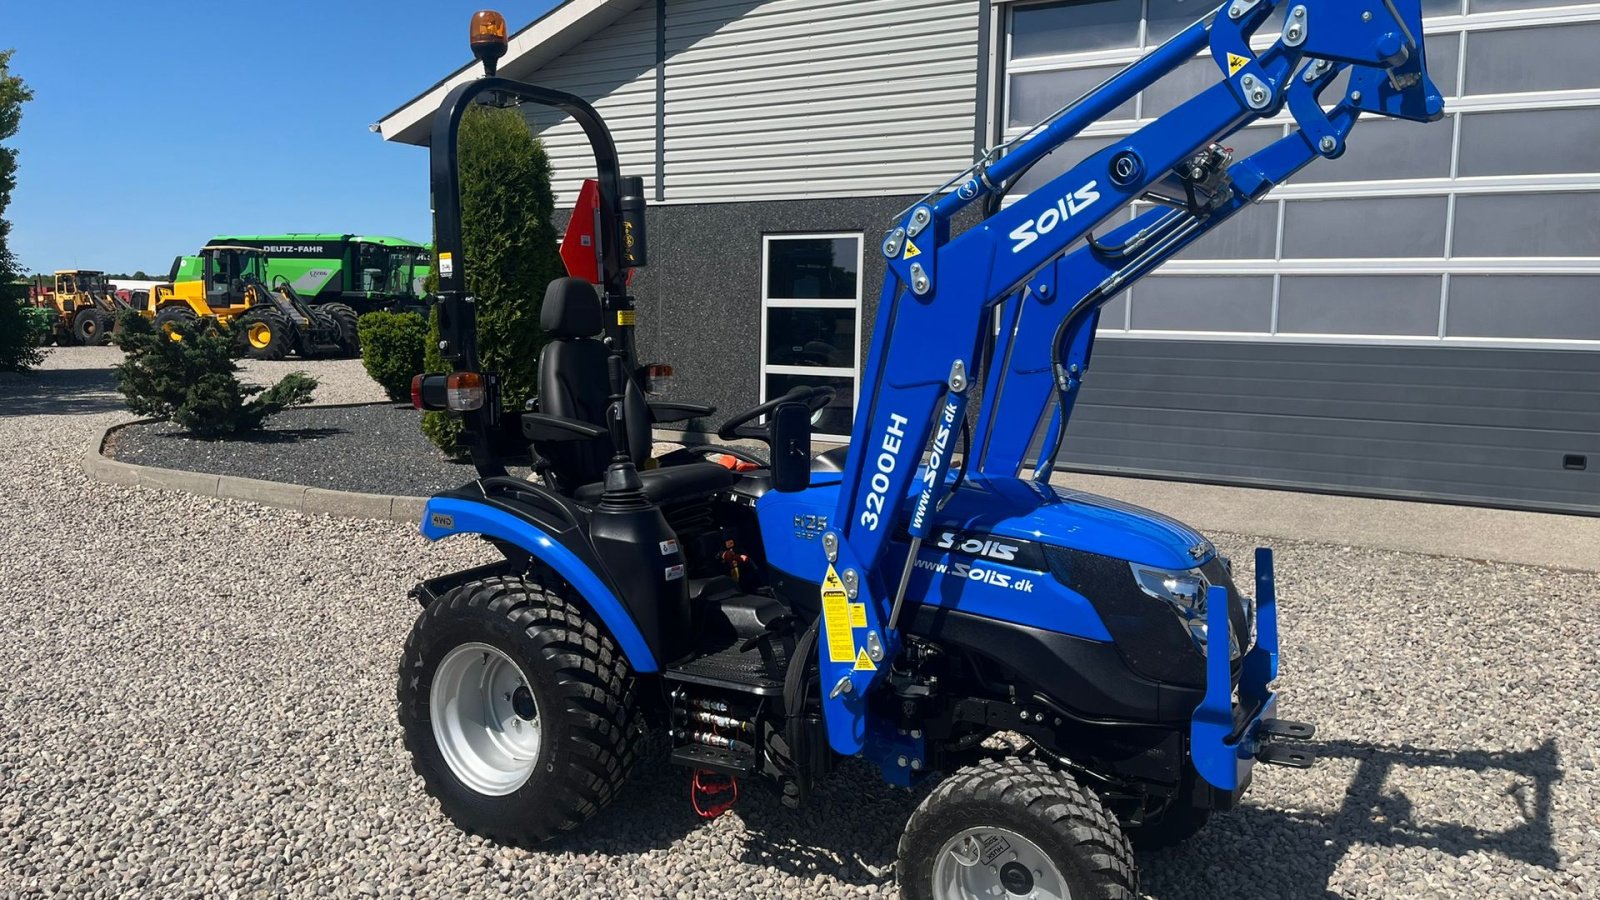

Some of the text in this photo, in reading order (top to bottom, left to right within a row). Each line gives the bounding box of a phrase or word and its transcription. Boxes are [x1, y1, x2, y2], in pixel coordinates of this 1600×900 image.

[263, 245, 324, 253] DEUTZ-FAHR
[861, 412, 908, 531] 3200EH
[987, 845, 1004, 859] HUSK
